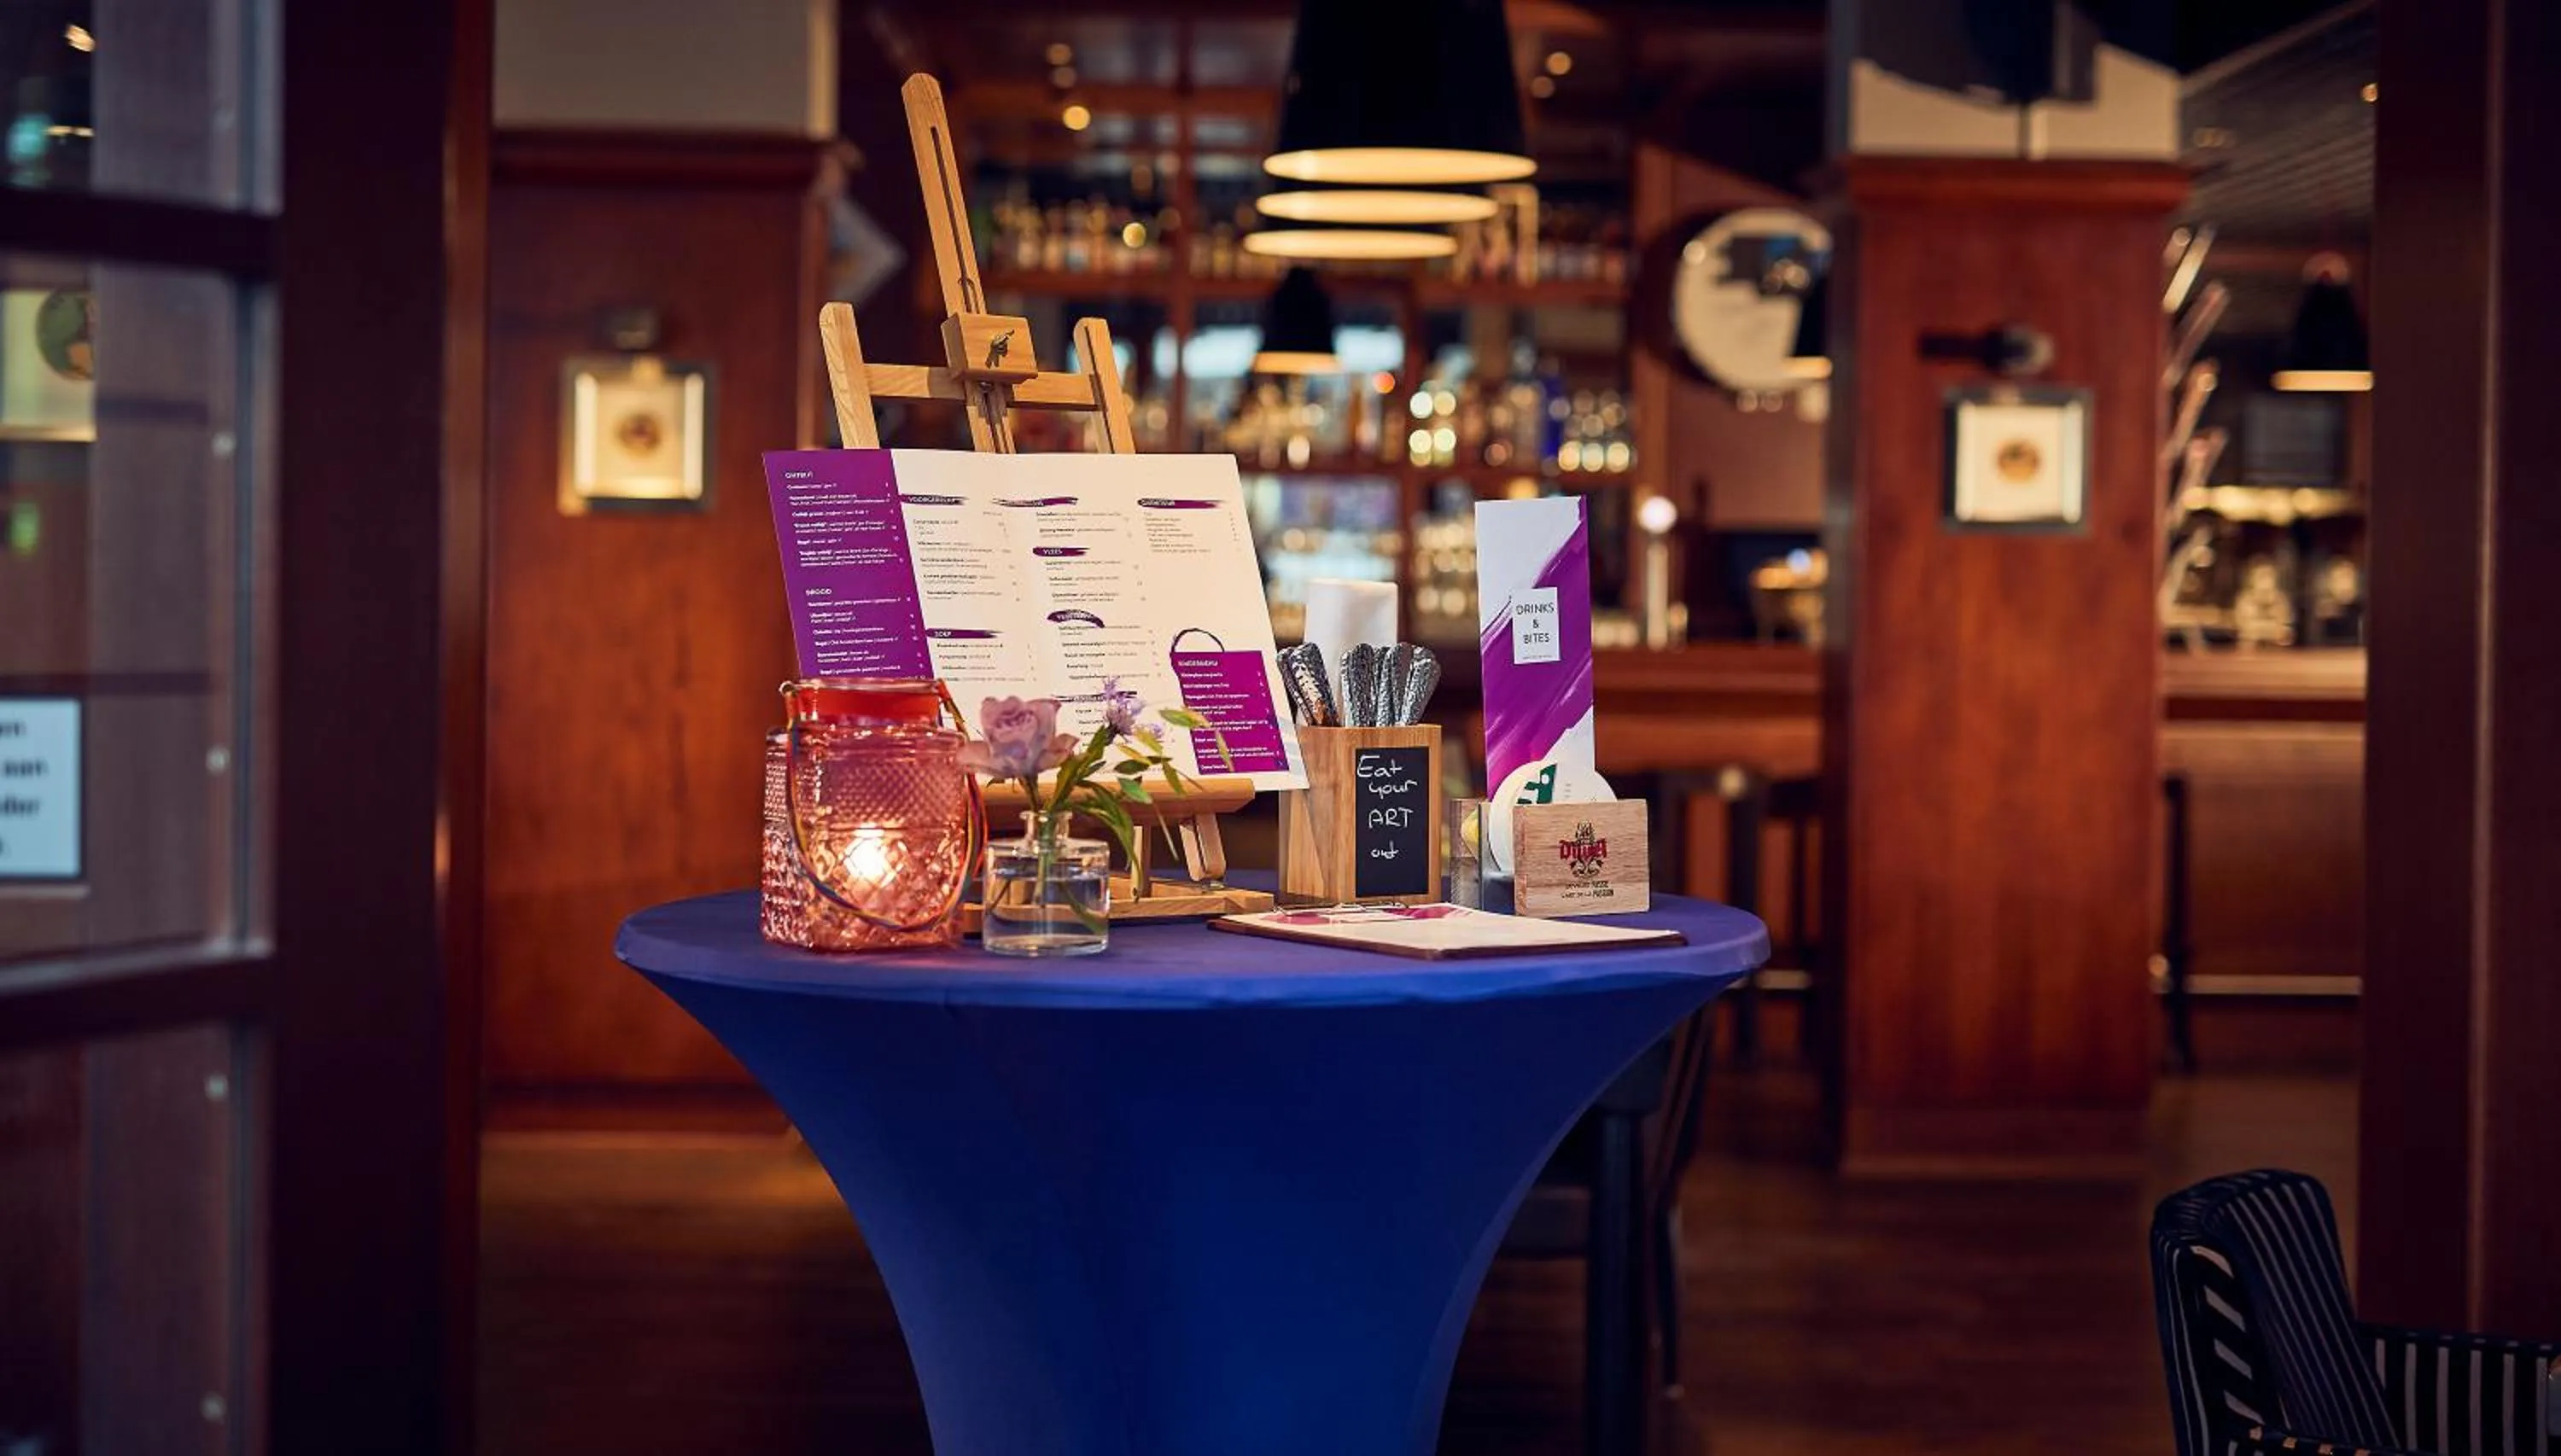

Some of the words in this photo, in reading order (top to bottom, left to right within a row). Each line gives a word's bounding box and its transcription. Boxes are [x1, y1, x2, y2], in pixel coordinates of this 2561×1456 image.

[1516, 602, 1555, 615] DRINKS
[1532, 619, 1539, 628] &
[1523, 632, 1550, 644] BITES
[1356, 754, 1403, 778] Eat
[1368, 779, 1418, 800] your
[1368, 807, 1414, 829] ART
[1370, 840, 1399, 859] out
